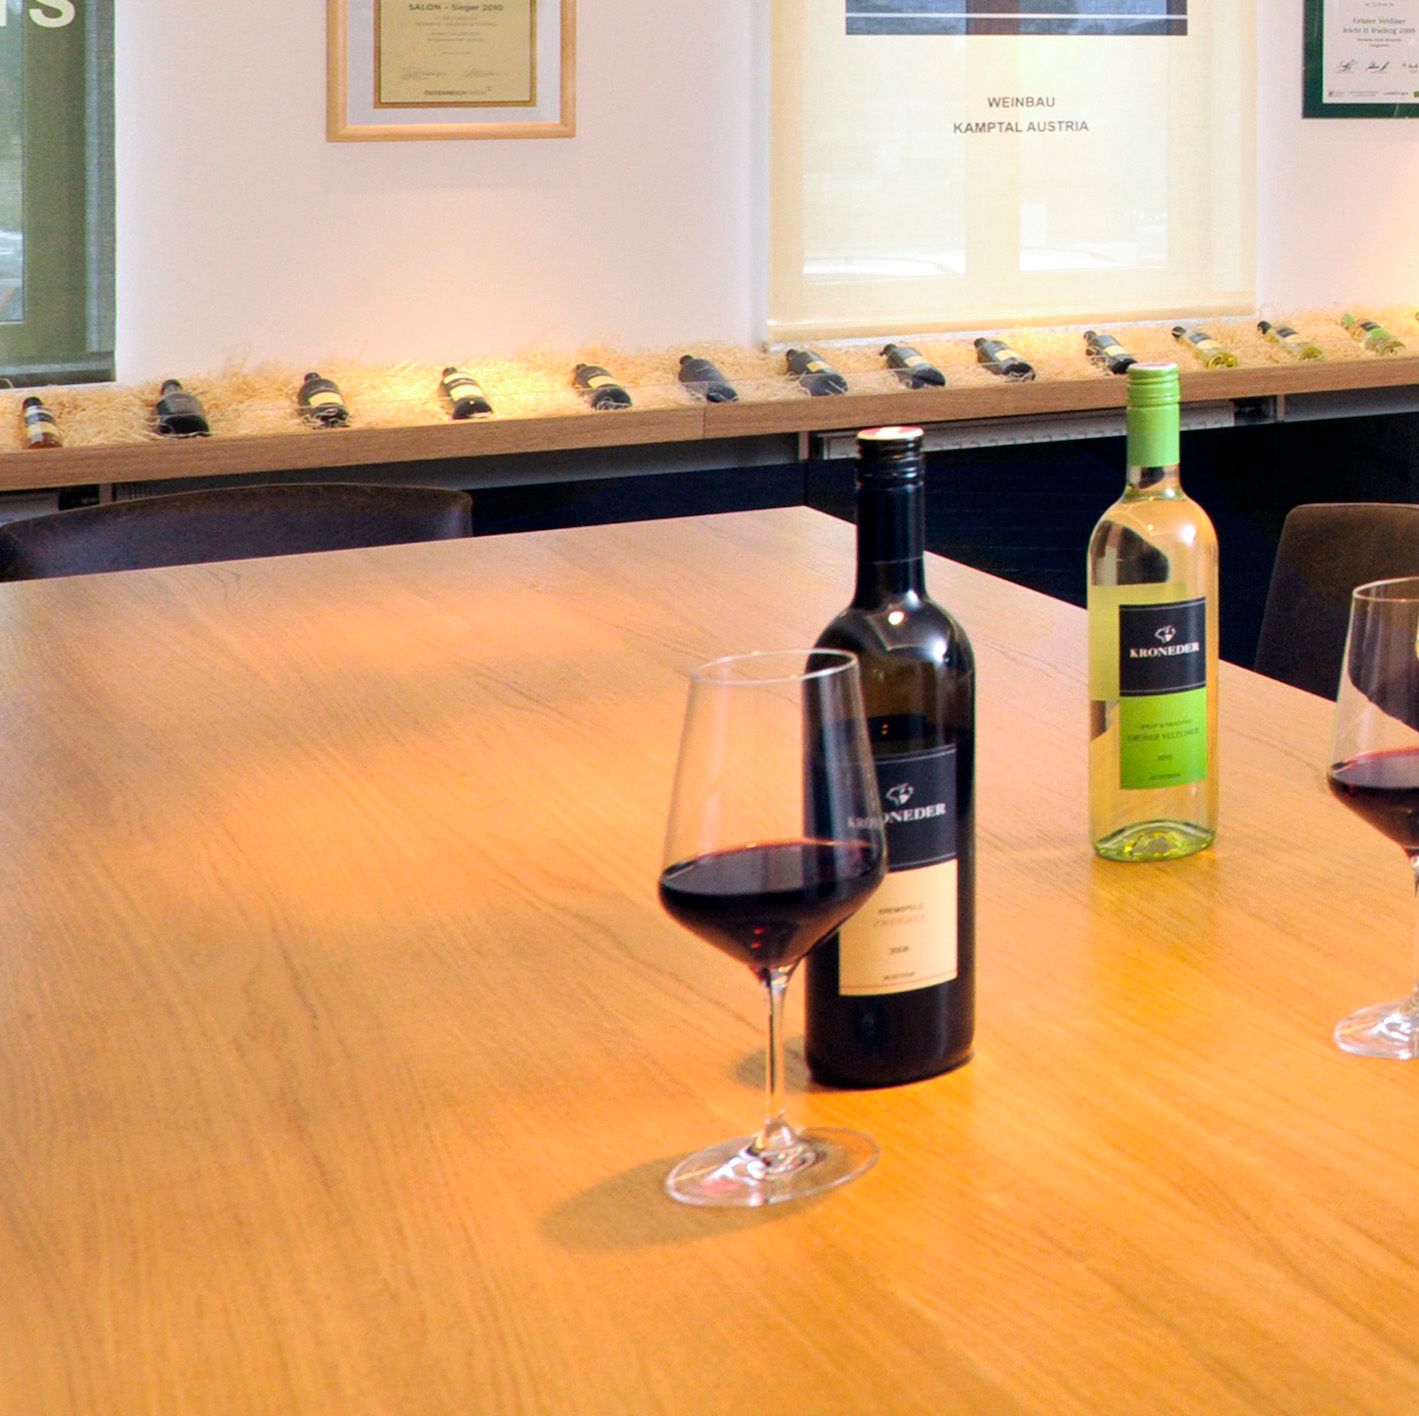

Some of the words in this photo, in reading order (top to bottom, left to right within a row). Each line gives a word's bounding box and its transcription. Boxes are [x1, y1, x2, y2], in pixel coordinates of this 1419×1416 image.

[408, 3, 442, 12] SALON
[987, 96, 1056, 108] WEINBAU
[953, 121, 1023, 134] KAMPTAL
[1026, 120, 1090, 133] AUSTRIA
[1129, 641, 1200, 659] KRONEDER
